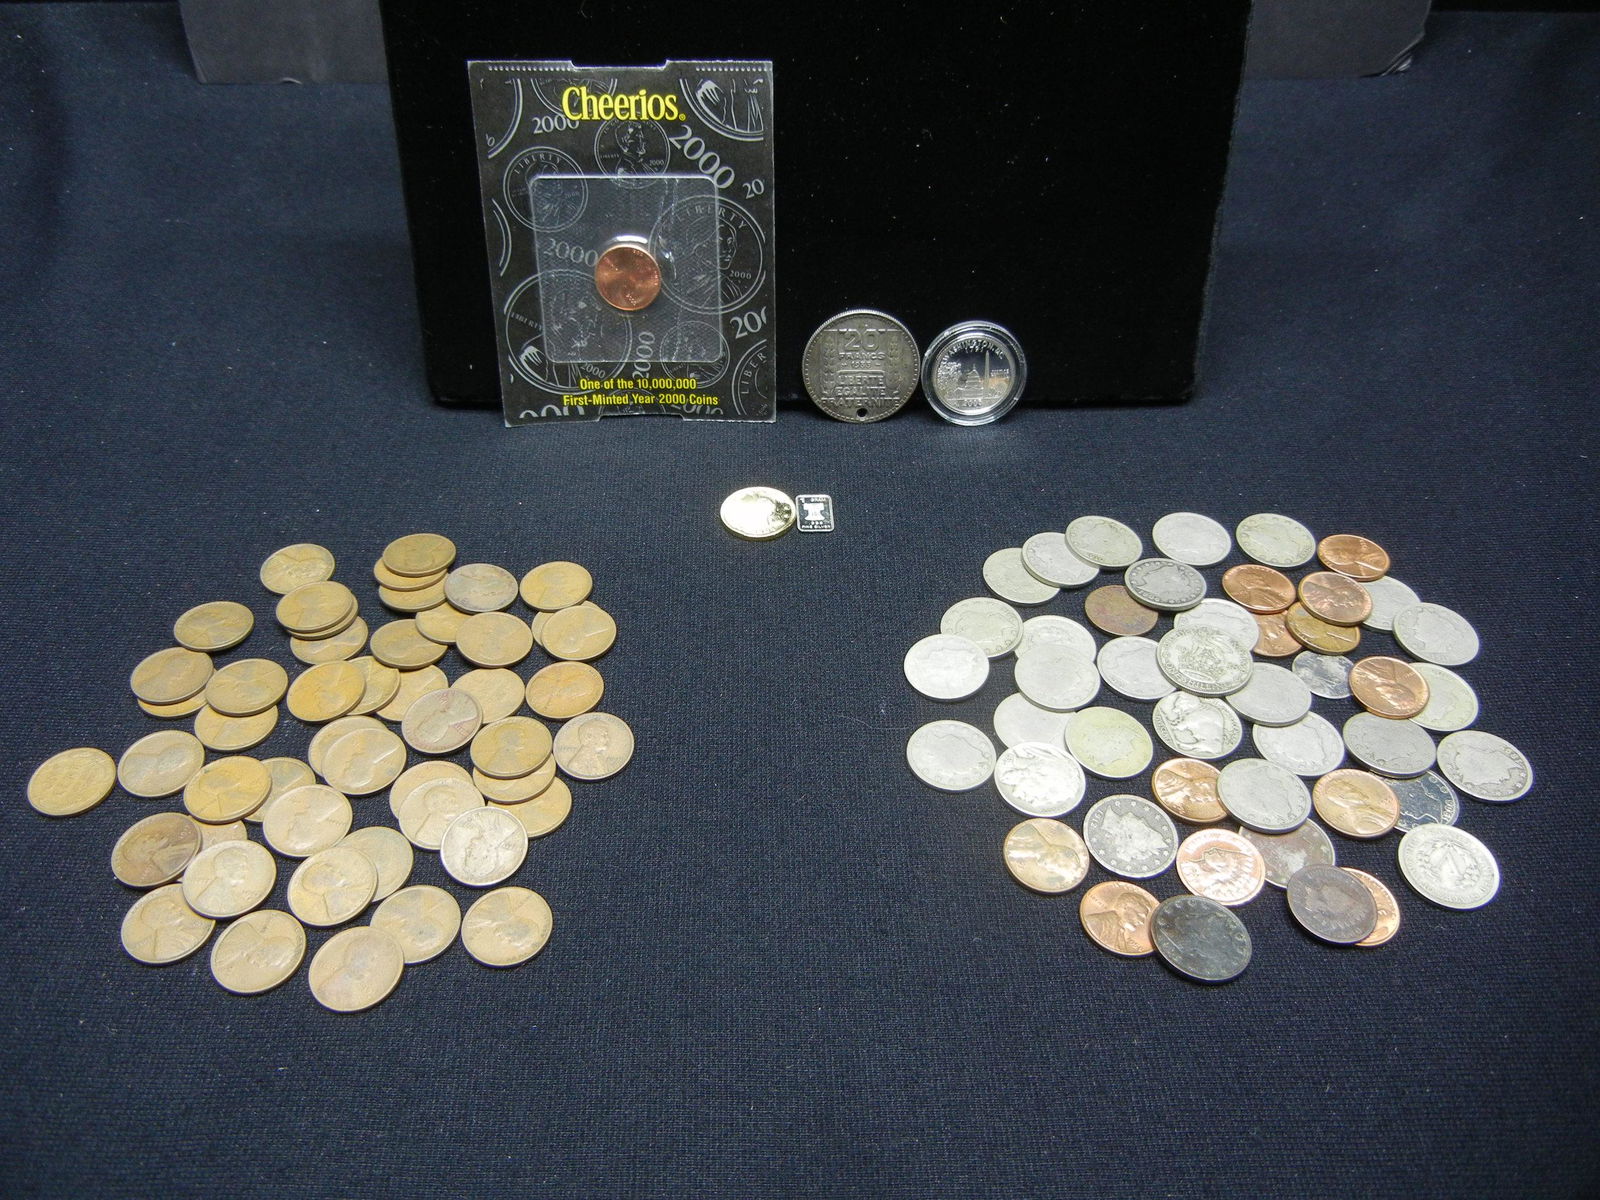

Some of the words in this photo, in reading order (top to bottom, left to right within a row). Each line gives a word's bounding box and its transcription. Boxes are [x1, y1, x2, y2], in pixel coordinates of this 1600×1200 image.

[668, 124, 736, 189] 2000
[729, 270, 752, 280] 2000
[845, 328, 880, 350] 20
[838, 352, 885, 361] FRANCS
[580, 378, 601, 390] One
[603, 378, 614, 390] of
[617, 378, 634, 390] the
[637, 378, 697, 390] 10,000,000
[563, 393, 629, 406] First-Minted
[632, 392, 655, 405] Year
[658, 393, 686, 405] 2000
[689, 393, 719, 405] Coins
